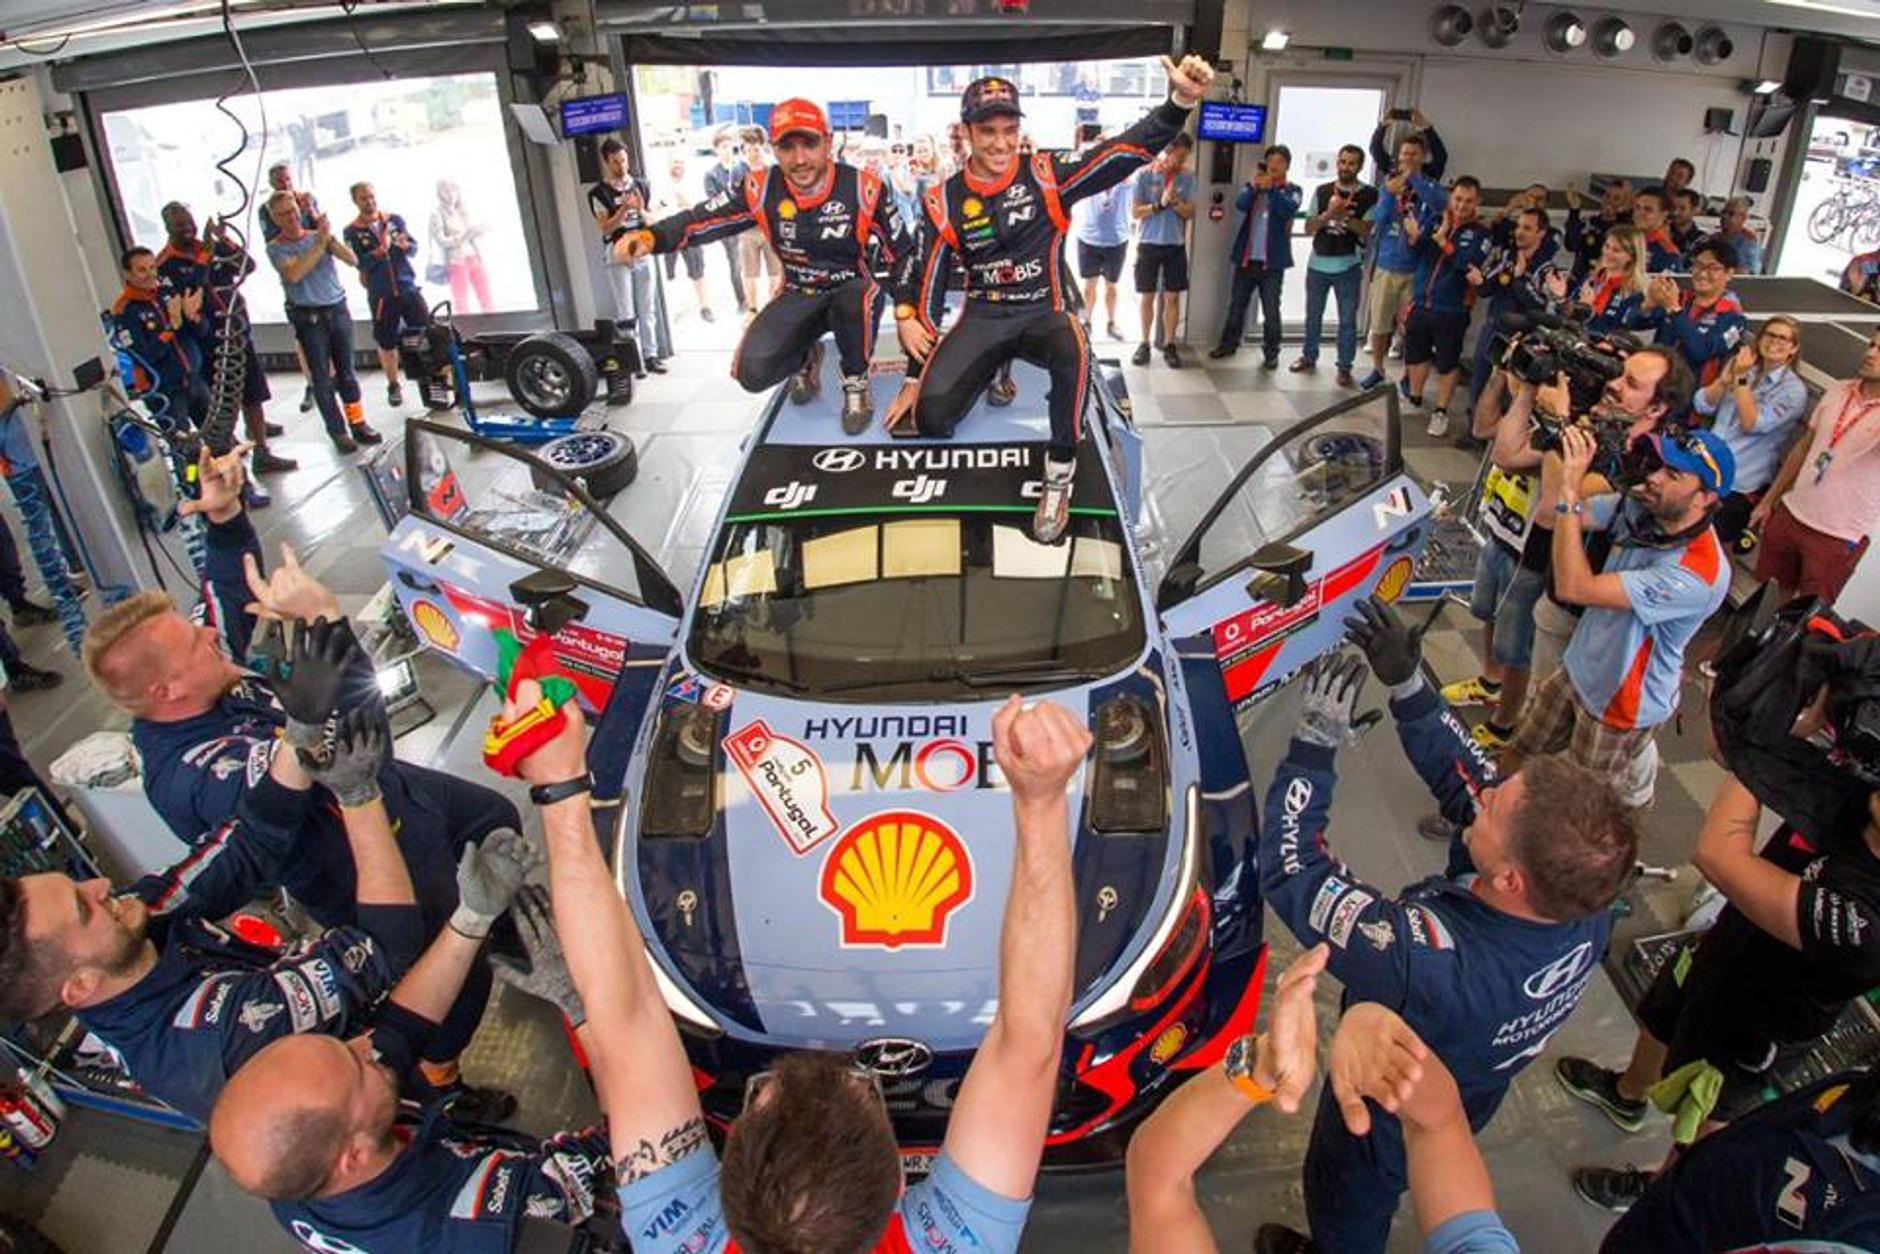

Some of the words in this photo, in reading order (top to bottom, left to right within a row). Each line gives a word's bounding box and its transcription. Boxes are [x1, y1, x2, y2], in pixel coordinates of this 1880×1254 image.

[983, 259, 1042, 284] MOBIS
[876, 448, 1030, 470] HYUNDAI
[763, 482, 818, 509] dji
[893, 475, 947, 503] dji
[804, 715, 968, 740] HYUNDAI
[791, 758, 812, 776] 5
[850, 738, 999, 793] MOB
[759, 759, 819, 839] Portugal
